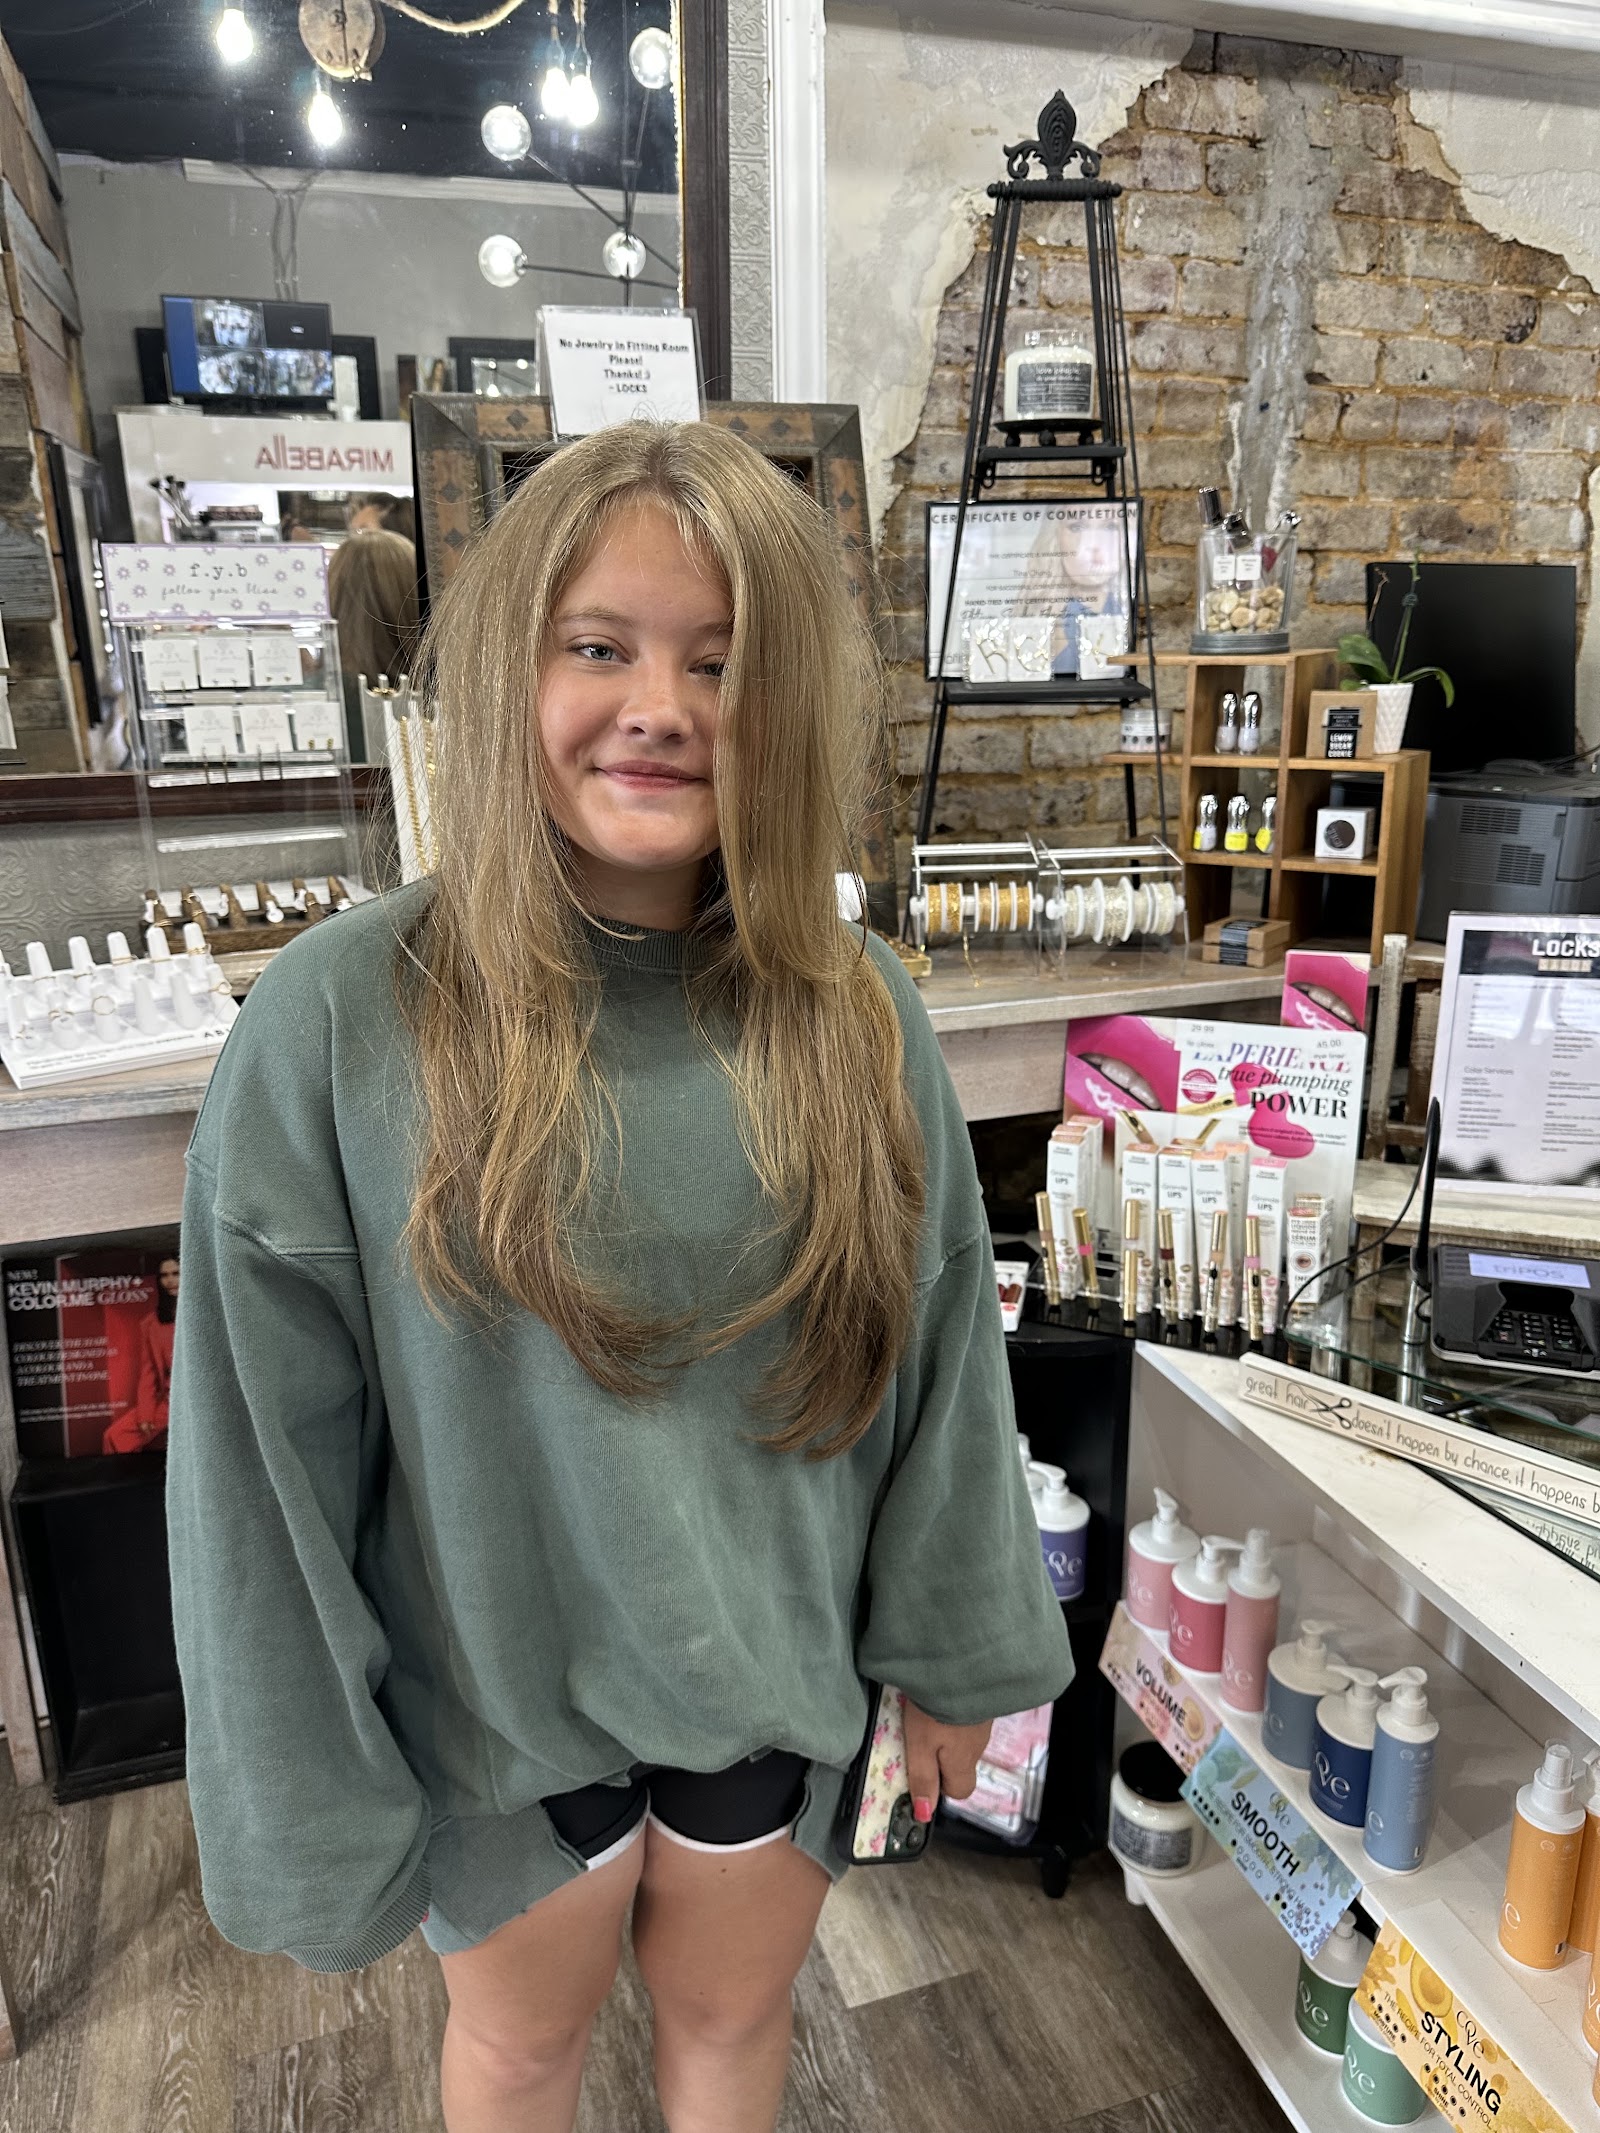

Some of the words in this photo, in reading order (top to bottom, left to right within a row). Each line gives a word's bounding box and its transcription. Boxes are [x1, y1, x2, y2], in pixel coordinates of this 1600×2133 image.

[559, 339, 573, 349] No
[575, 340, 614, 351] Jewelry
[627, 341, 660, 353] Fitting
[662, 343, 690, 353] Room
[616, 383, 648, 393] LOCKS
[931, 511, 1018, 525] CERIFICATE
[1023, 511, 1041, 522] OF
[1047, 508, 1138, 522] COMPLETION
[1531, 938, 1600, 958] LOCKS
[1193, 1042, 1353, 1074] PERIECE
[1218, 1066, 1256, 1082] true
[1258, 1068, 1353, 1097] plumping
[1250, 1090, 1348, 1120] POWER
[1493, 1264, 1565, 1280] triPOS
[96, 1288, 150, 1305] GLOSS
[1245, 1376, 1279, 1400] great
[1285, 1384, 1309, 1411] hair
[1351, 1409, 1392, 1441] doesn't
[1396, 1423, 1440, 1459] happen
[1444, 1440, 1460, 1467] by
[1463, 1448, 1512, 1485] chance,
[1515, 1466, 1525, 1488] it
[1530, 1469, 1587, 1511] happens
[1135, 1657, 1187, 1729] VOLUME
[1231, 1790, 1301, 1878] SMOOTH
[1383, 1991, 1397, 2012] THE
[1396, 2007, 1421, 2040] RECIPE
[1419, 2036, 1436, 2060] FOR
[1435, 2055, 1457, 2087] TOTAL
[1457, 2083, 1492, 2131] CONTROL
[1420, 2010, 1502, 2116] STYLING
[1433, 2087, 1449, 2107] SHINE
